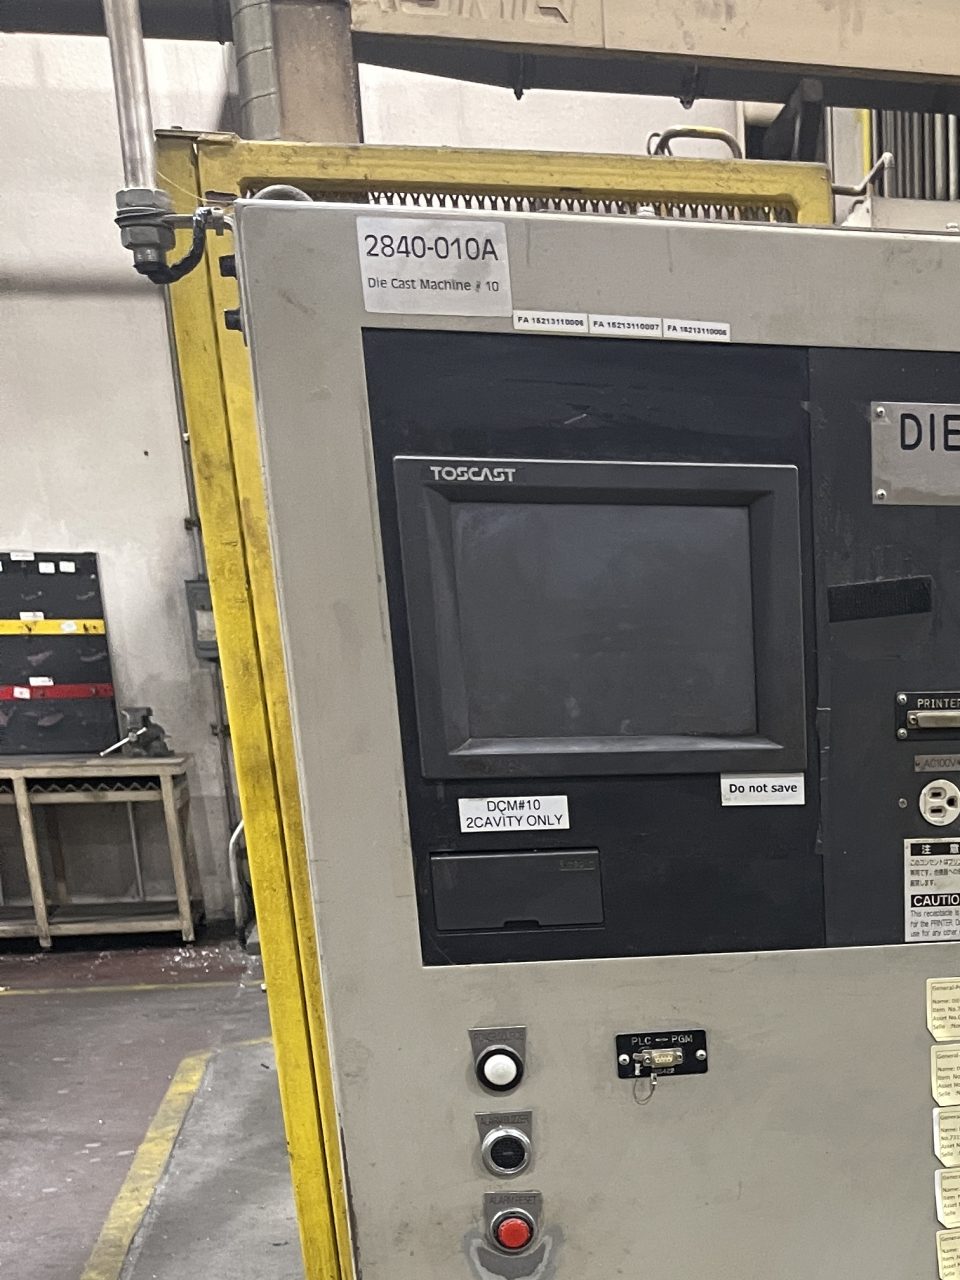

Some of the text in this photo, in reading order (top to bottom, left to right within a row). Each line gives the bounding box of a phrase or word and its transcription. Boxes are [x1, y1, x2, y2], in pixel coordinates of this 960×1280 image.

[365, 235, 498, 260] 2840-010A
[368, 277, 388, 289] Die
[391, 278, 416, 290] Cast
[420, 278, 471, 291] Machine
[486, 281, 499, 292] 10
[517, 316, 529, 324] FA
[593, 320, 604, 328] FA
[430, 466, 517, 483] TOSCAST
[729, 783, 798, 794] Do not save
[486, 799, 541, 814] DCM#10
[466, 814, 564, 829] 2CAVITY ONLY
[910, 909, 922, 917] This
[631, 1036, 651, 1045] PLC
[672, 1034, 693, 1043] PGM
